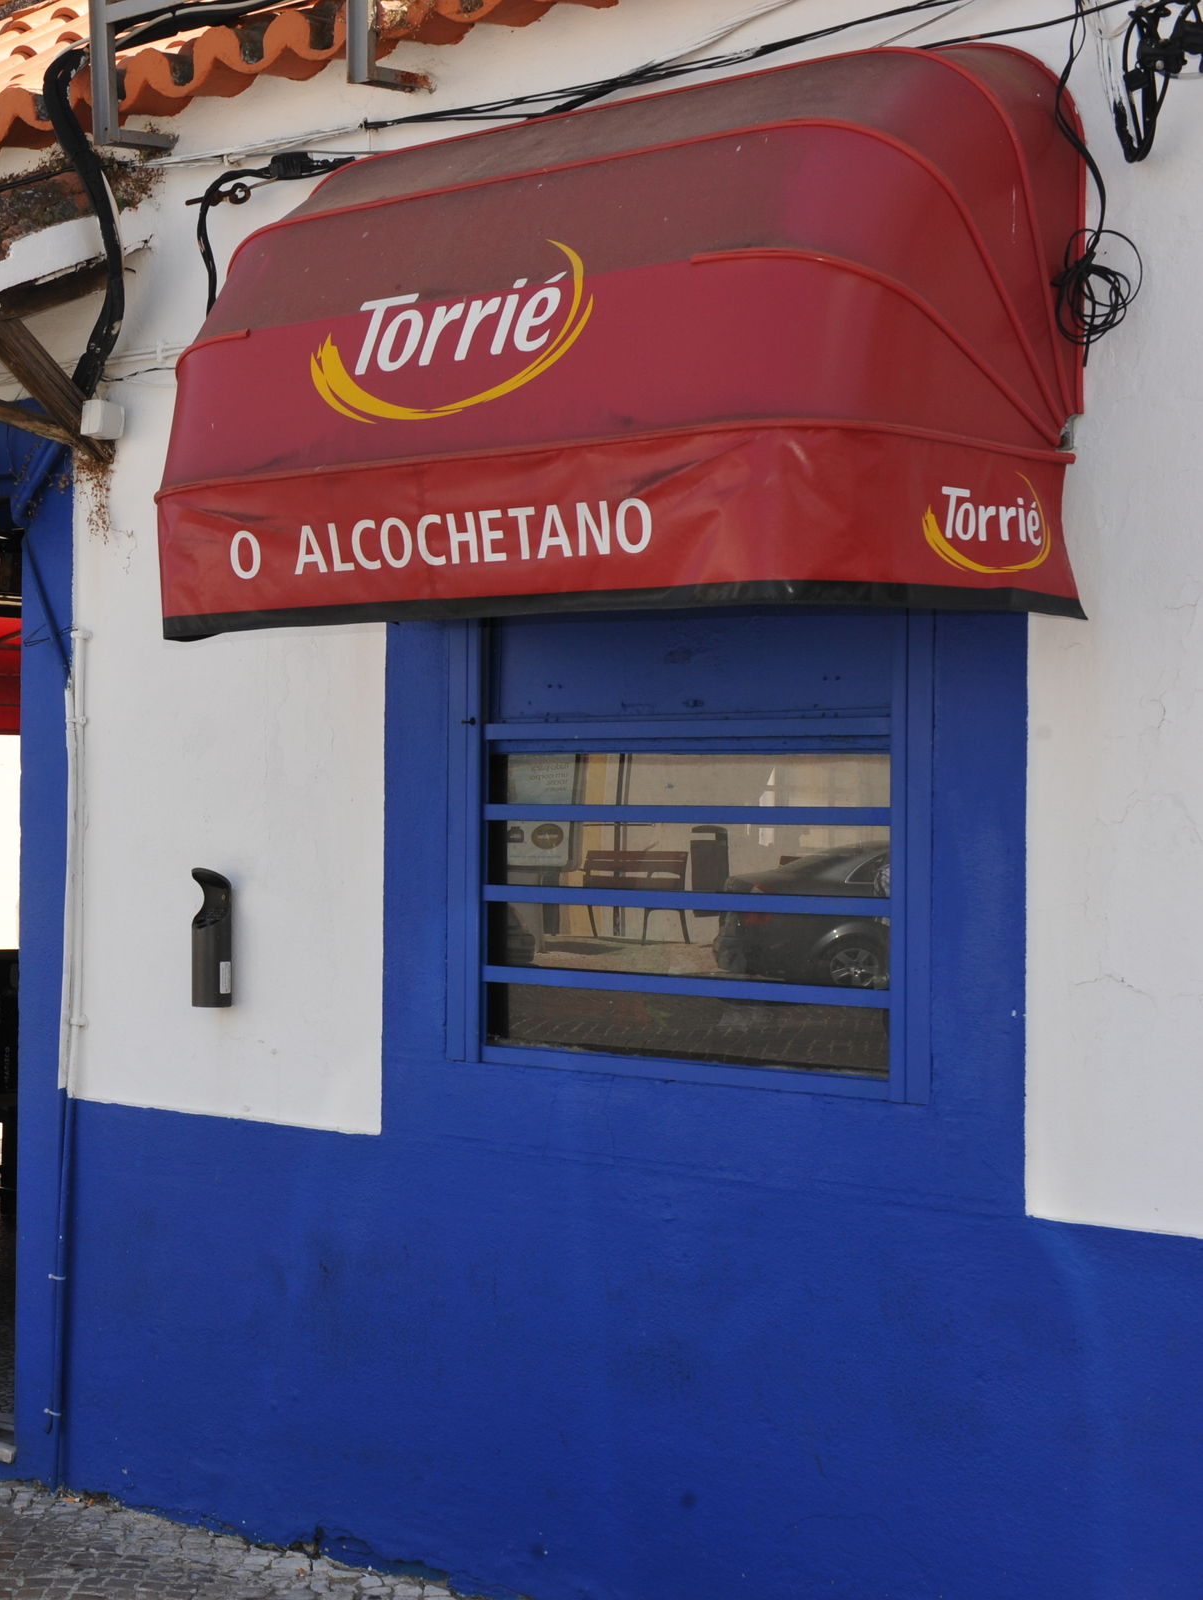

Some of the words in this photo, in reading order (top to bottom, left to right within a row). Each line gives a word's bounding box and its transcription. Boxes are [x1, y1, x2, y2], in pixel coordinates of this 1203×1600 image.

[353, 272, 565, 376] Torrié
[230, 529, 262, 580] O
[294, 496, 653, 576] ALCOCHETANO
[939, 485, 1042, 547] Torrié
[3, 1046, 11, 1084] MARISCO
